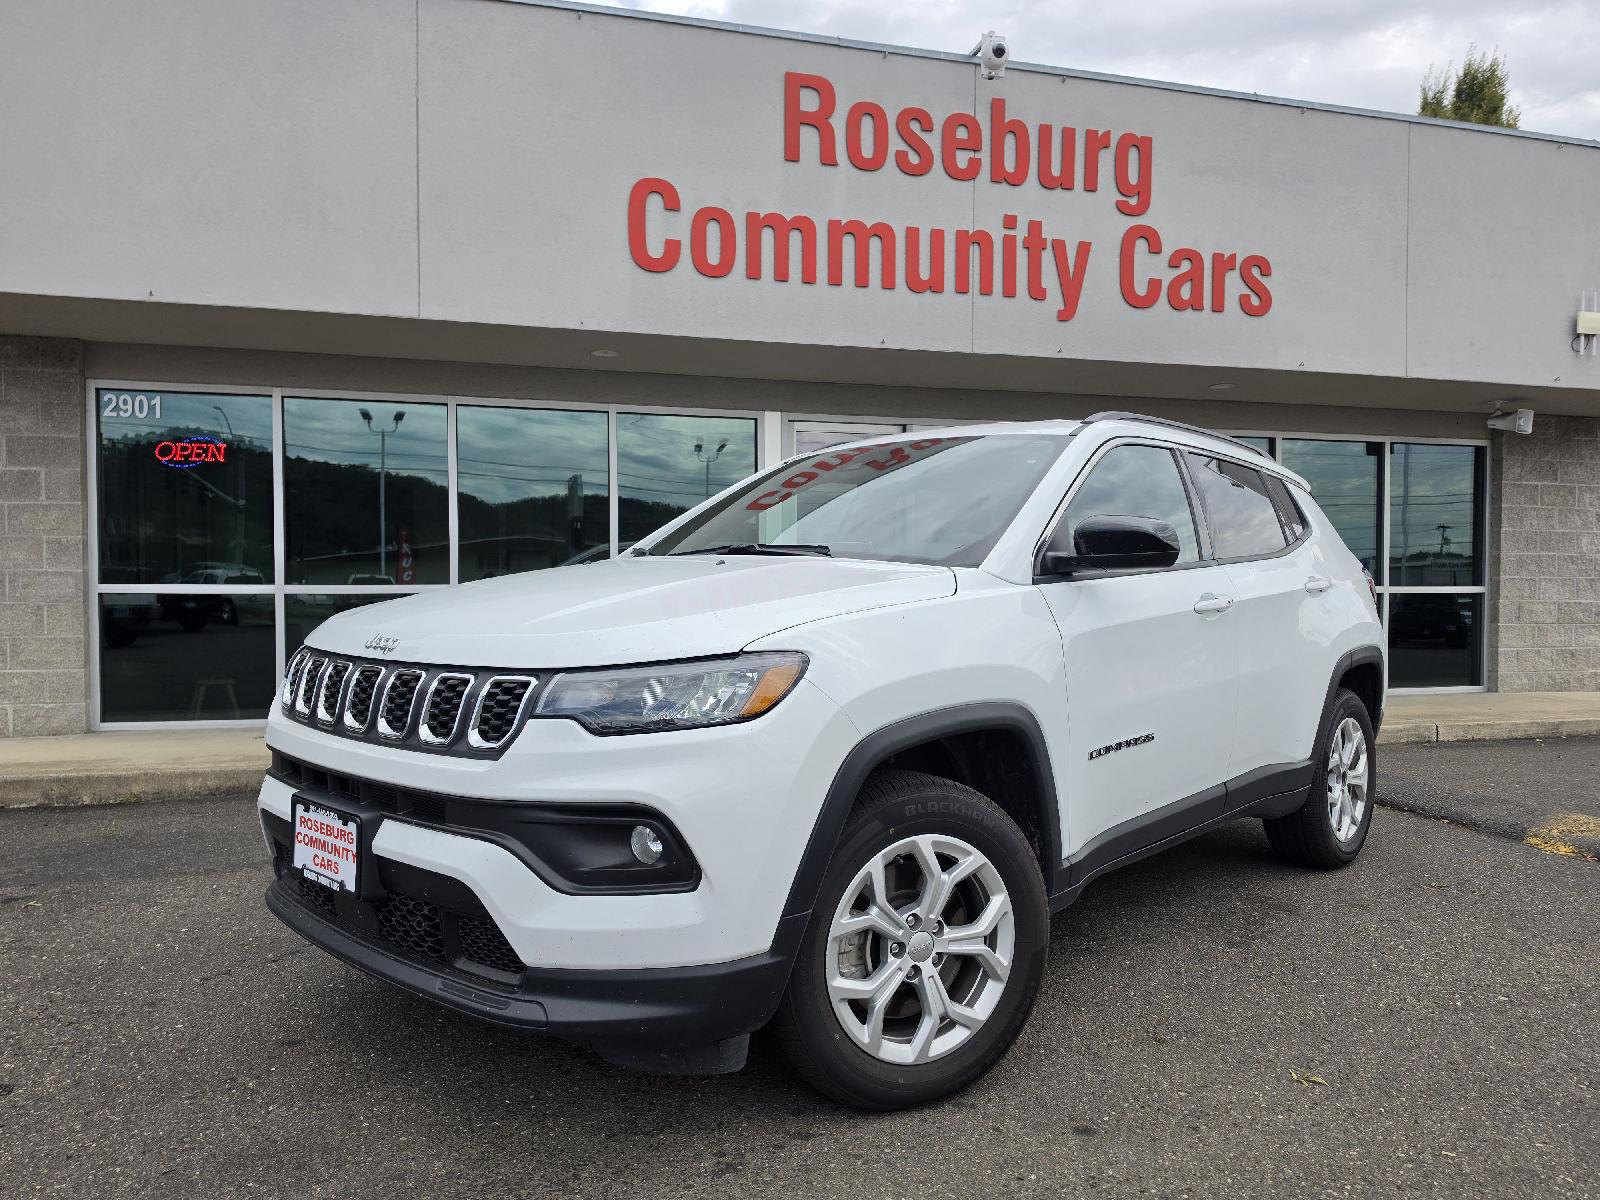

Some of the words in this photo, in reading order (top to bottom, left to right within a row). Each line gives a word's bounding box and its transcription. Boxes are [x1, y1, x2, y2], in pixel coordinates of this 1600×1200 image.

[784, 71, 1152, 216] Roseburg
[628, 178, 1091, 321] Community
[1119, 224, 1273, 318] Cars
[103, 394, 160, 418] 2901
[155, 441, 226, 462] OPEN
[365, 633, 400, 655] Jeep
[1087, 732, 1154, 760] COMPASS
[300, 816, 353, 844] ROSEBURG
[296, 832, 357, 863] COMMUNITY
[313, 854, 339, 874] CARS
